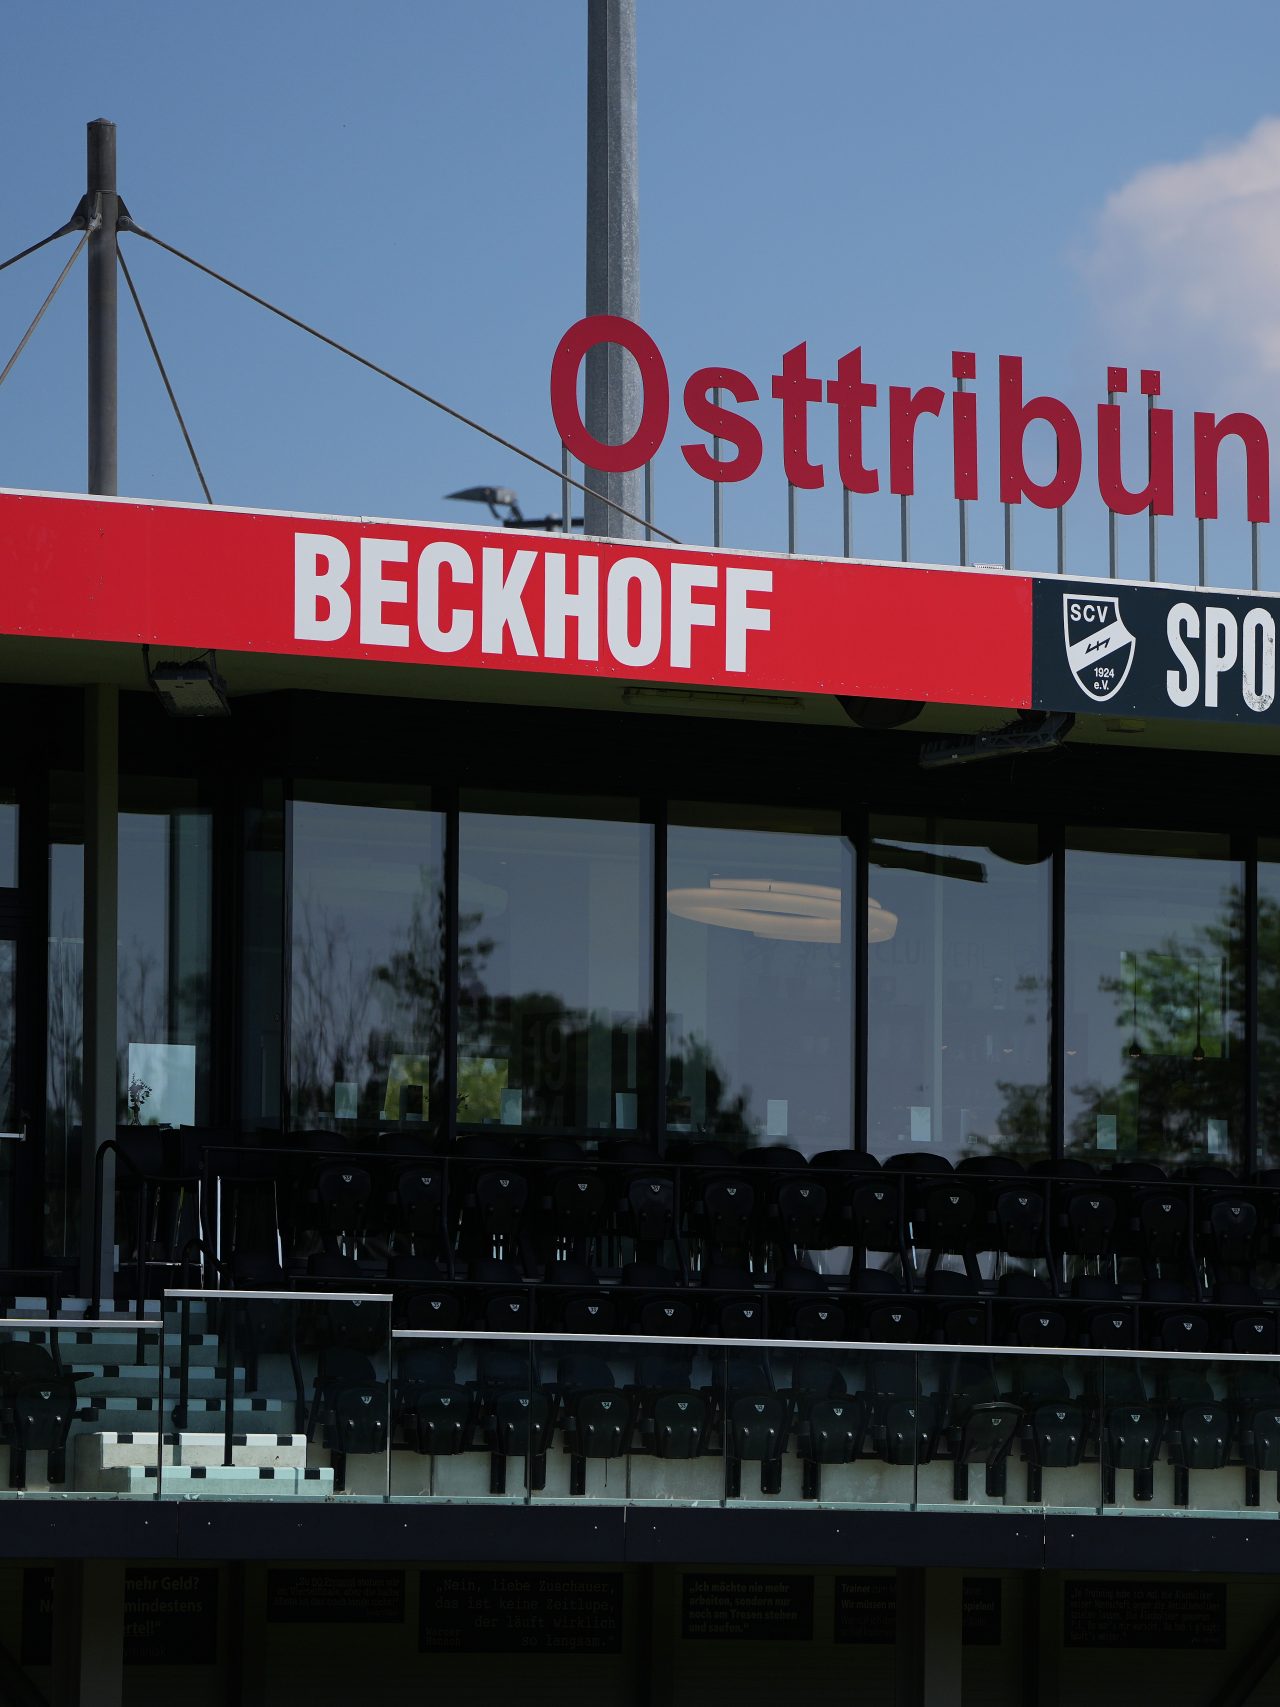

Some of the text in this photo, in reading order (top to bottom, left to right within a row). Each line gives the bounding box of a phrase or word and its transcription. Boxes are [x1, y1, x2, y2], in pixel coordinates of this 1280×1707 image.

[294, 532, 773, 673] BECKHOFF
[1070, 603, 1108, 623] SCV
[1093, 667, 1115, 678] 1924
[1093, 679, 1109, 690] e.V.
[125, 1576, 200, 1590] mehr Geld?
[492, 1578, 531, 1592] liebe
[539, 1579, 615, 1596] Zuschauer,
[711, 1581, 747, 1592] möchte
[748, 1581, 764, 1593] nie
[765, 1581, 791, 1593] mehr
[841, 1583, 871, 1593] Trainer
[125, 1597, 203, 1613] mindestens
[434, 1596, 615, 1613] das ist keine Zeitlupe,
[689, 1594, 733, 1607] arbeiten,
[735, 1595, 773, 1606] sondern
[841, 1599, 854, 1609] Wir
[856, 1599, 887, 1609] müssen
[689, 1608, 712, 1619] noch
[729, 1609, 763, 1620] Tresen
[764, 1608, 799, 1620] stehen
[474, 1615, 616, 1629] der läuft wirklich
[688, 1621, 707, 1633] und
[521, 1636, 538, 1647] so
